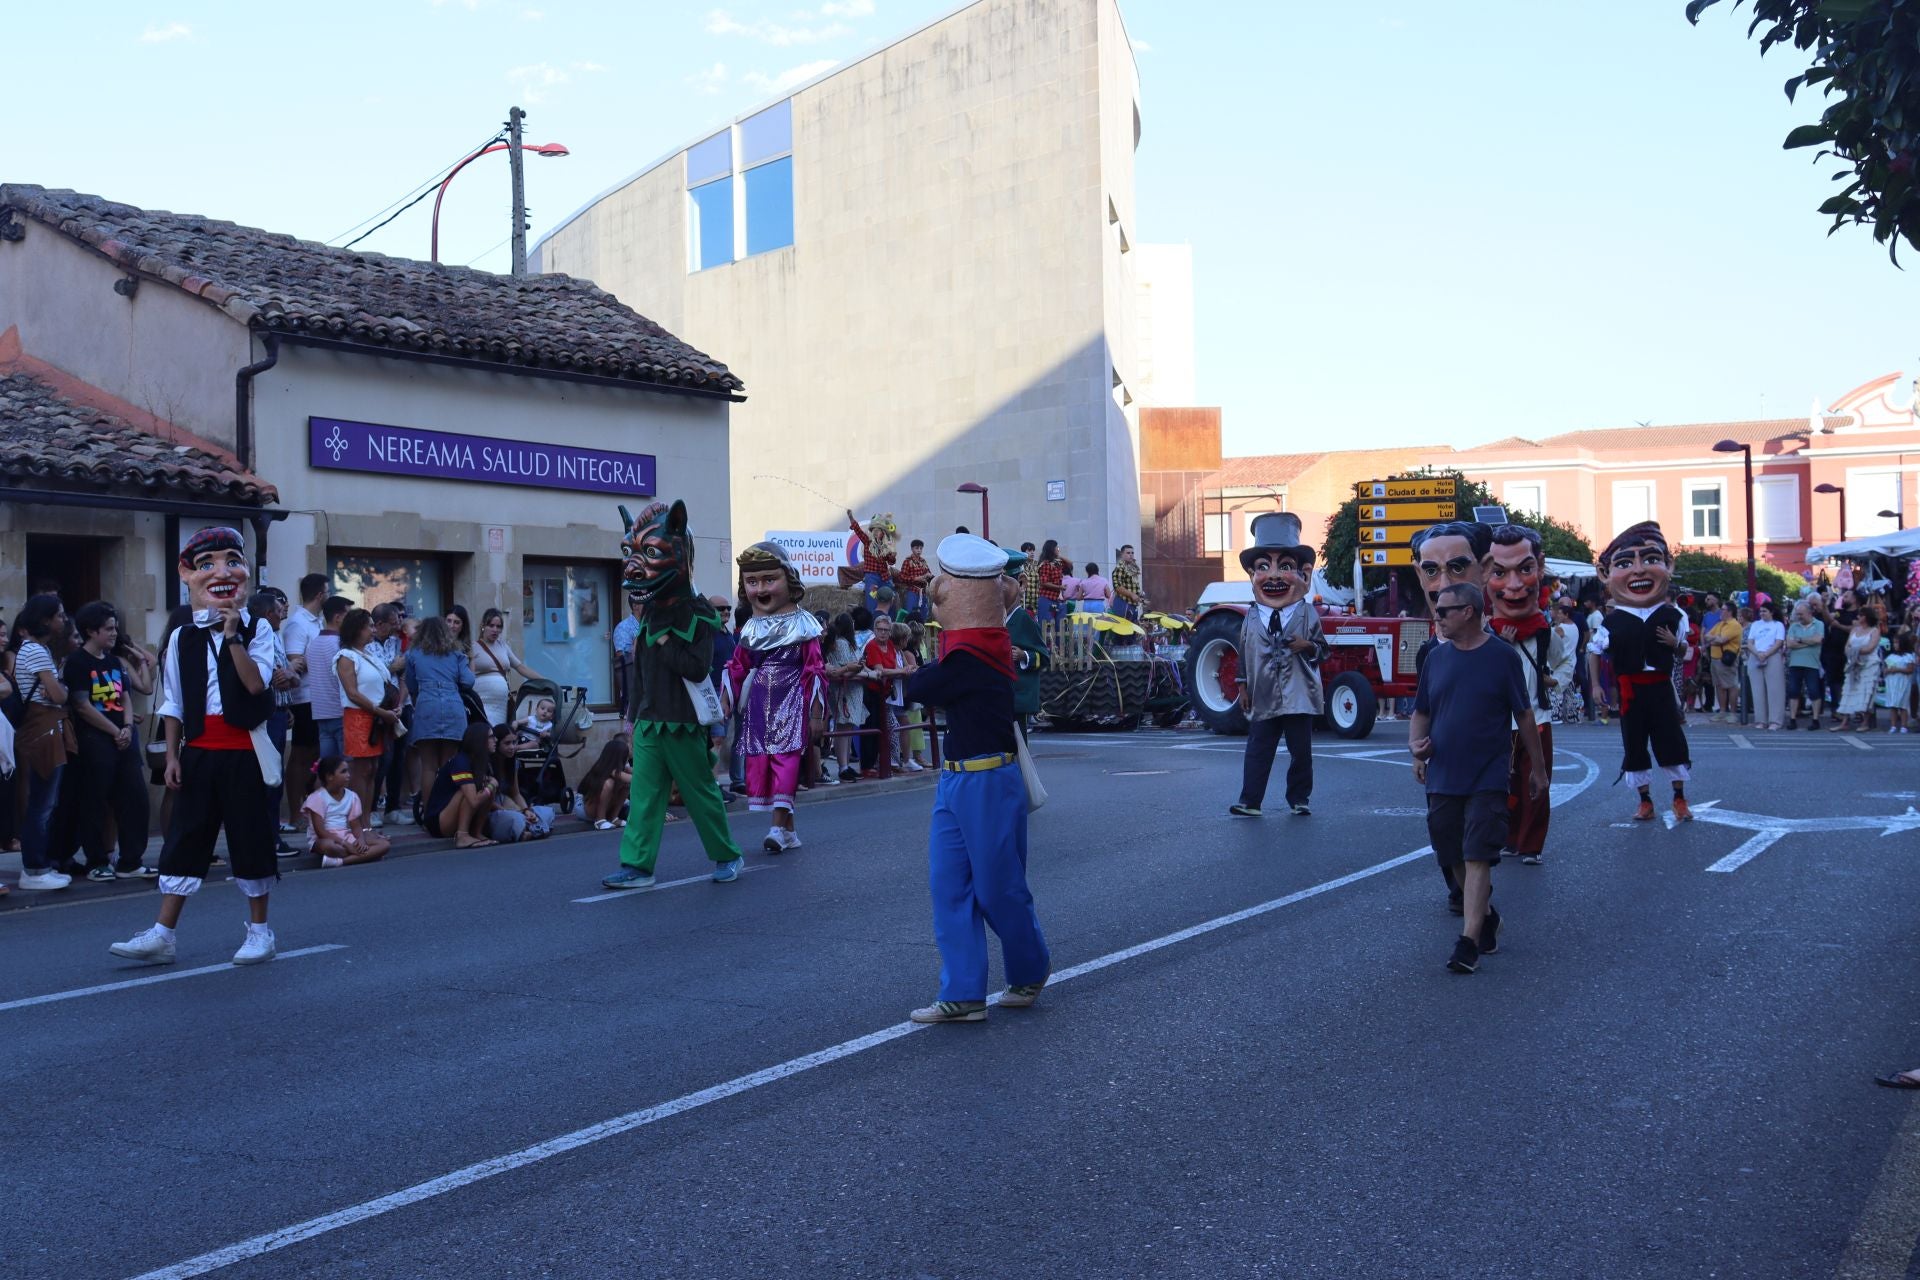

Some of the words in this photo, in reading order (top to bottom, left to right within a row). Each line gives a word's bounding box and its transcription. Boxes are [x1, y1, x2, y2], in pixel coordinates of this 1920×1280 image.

[367, 433, 475, 470] NEREAMA
[482, 447, 550, 477] SALUD
[557, 455, 646, 486] INTEGRAL
[1434, 487, 1454, 495] Haro
[807, 537, 844, 549] Juvenil
[788, 551, 835, 564] unicipal
[801, 564, 835, 576] Haro
